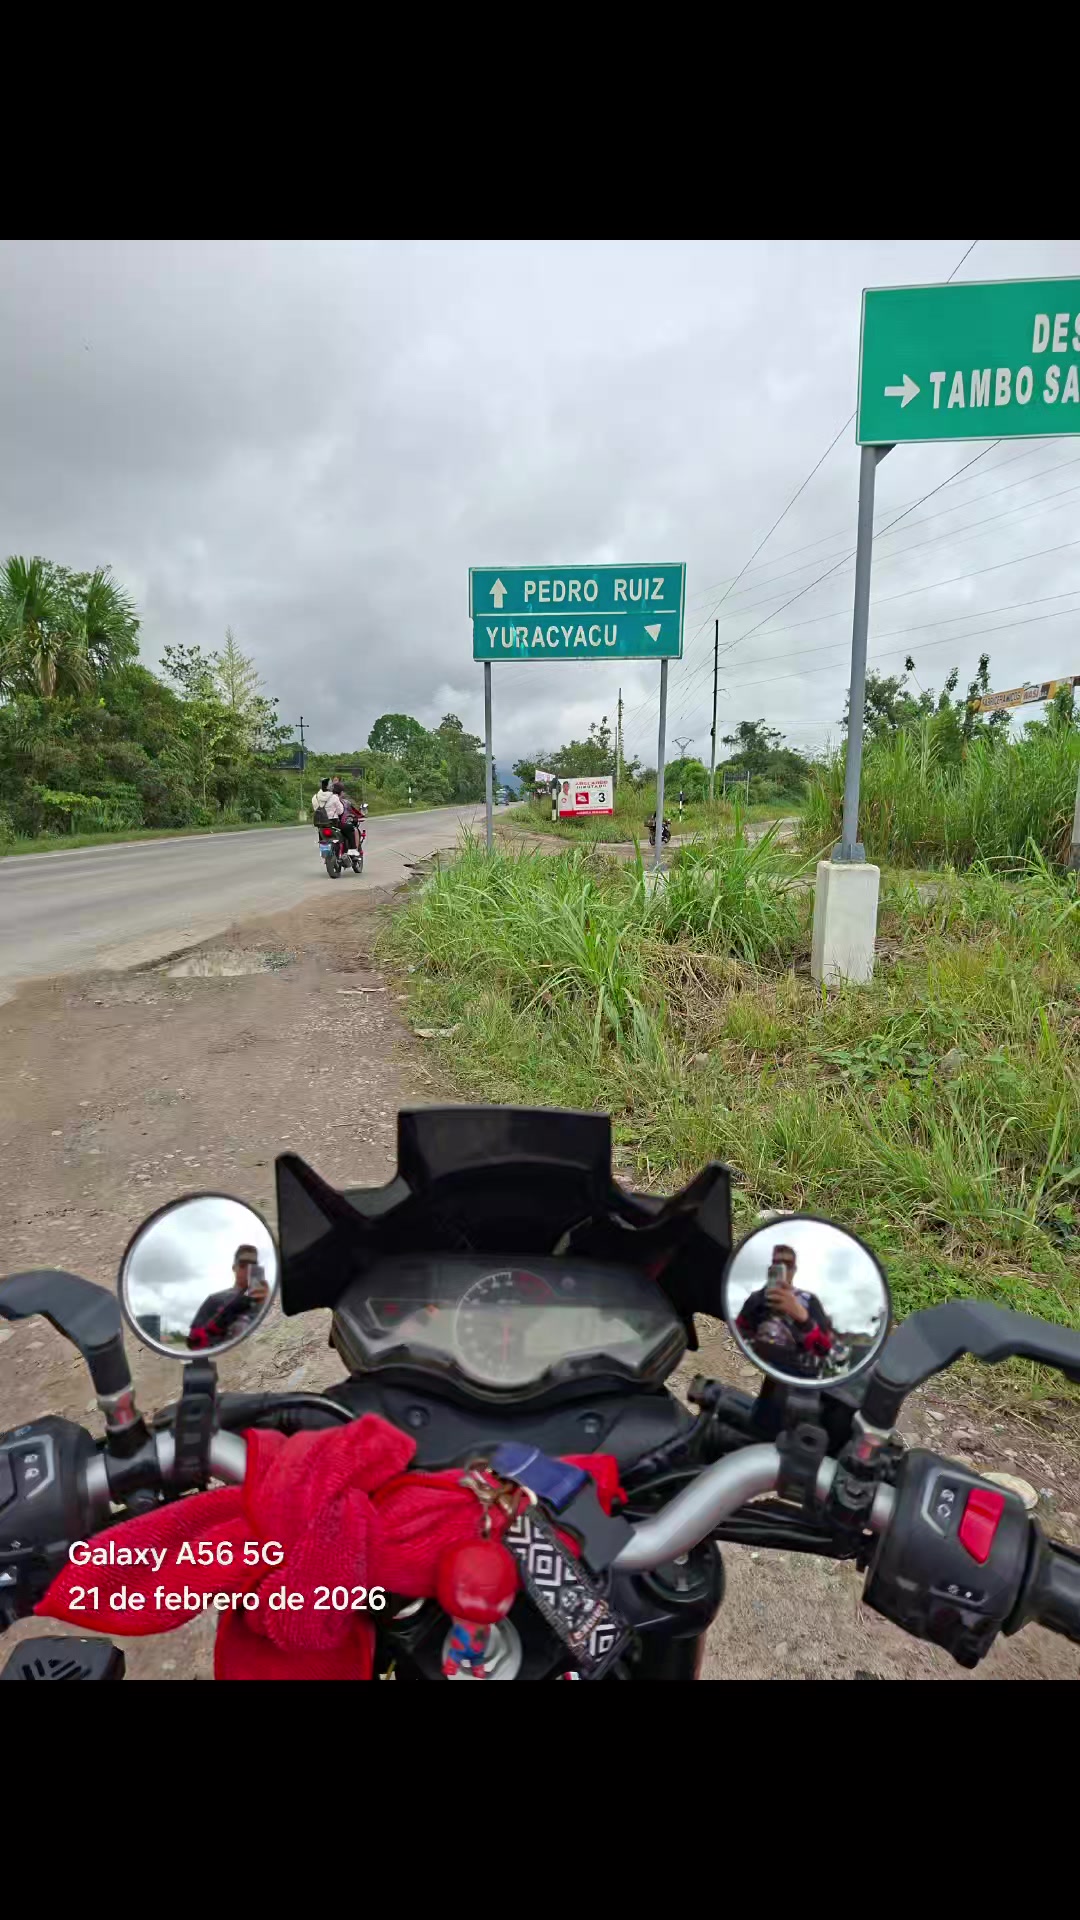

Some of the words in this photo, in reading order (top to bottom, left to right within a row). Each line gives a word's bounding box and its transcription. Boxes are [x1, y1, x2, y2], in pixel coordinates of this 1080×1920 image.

[929, 365, 1034, 409] TAMBO
[1043, 364, 1080, 404] SA
[524, 579, 599, 603] PEDRO
[614, 577, 665, 602] RUIZ
[486, 624, 618, 648] YURACYACU
[598, 792, 606, 803] 3
